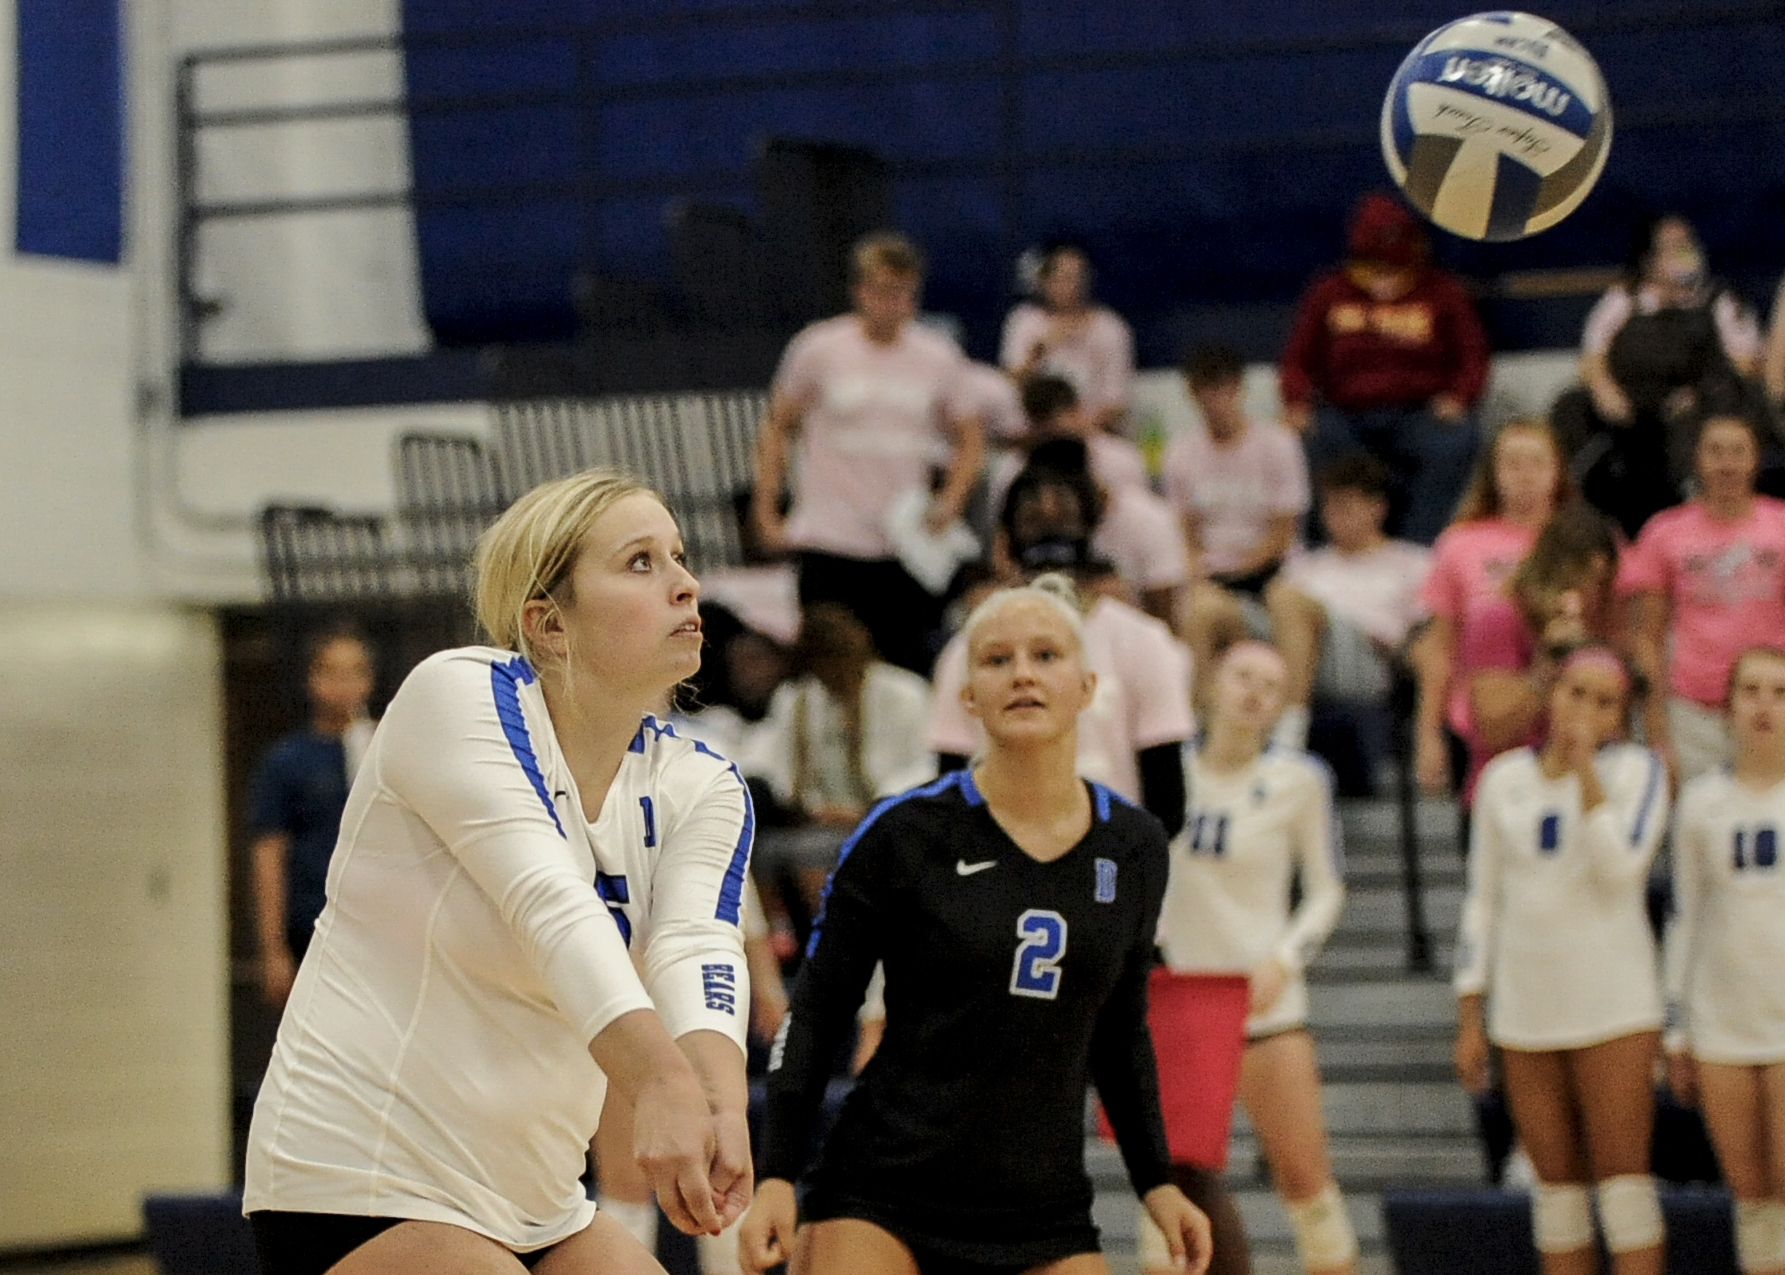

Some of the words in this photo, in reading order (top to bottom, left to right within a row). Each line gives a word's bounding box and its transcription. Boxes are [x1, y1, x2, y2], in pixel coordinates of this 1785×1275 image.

[1437, 56, 1570, 117] molten
[1010, 909, 1067, 1000] 2
[701, 963, 735, 1015] BEARS
